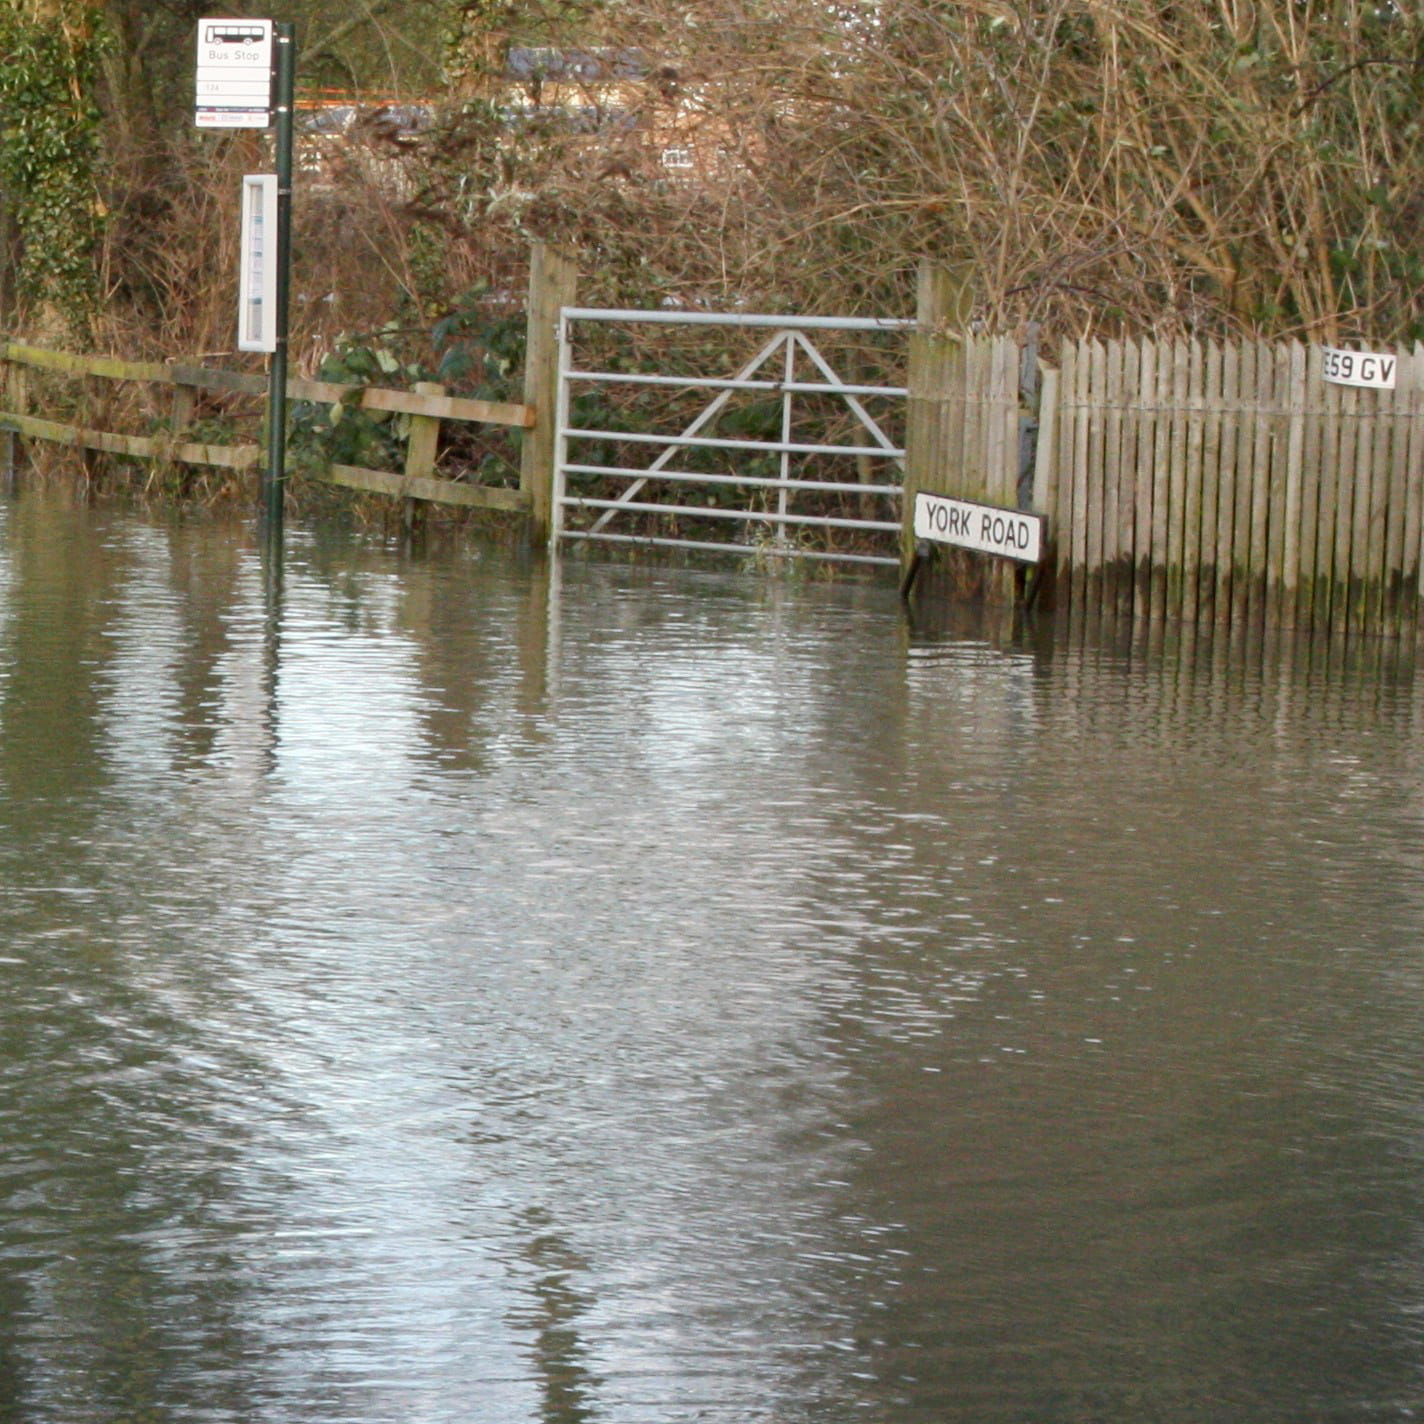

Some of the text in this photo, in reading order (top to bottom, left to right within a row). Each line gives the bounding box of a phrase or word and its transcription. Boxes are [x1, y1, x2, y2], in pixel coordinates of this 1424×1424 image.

[208, 50, 260, 61] Bus Stop
[1360, 358, 1394, 383] GV
[926, 502, 1029, 549] YORK ROAD
